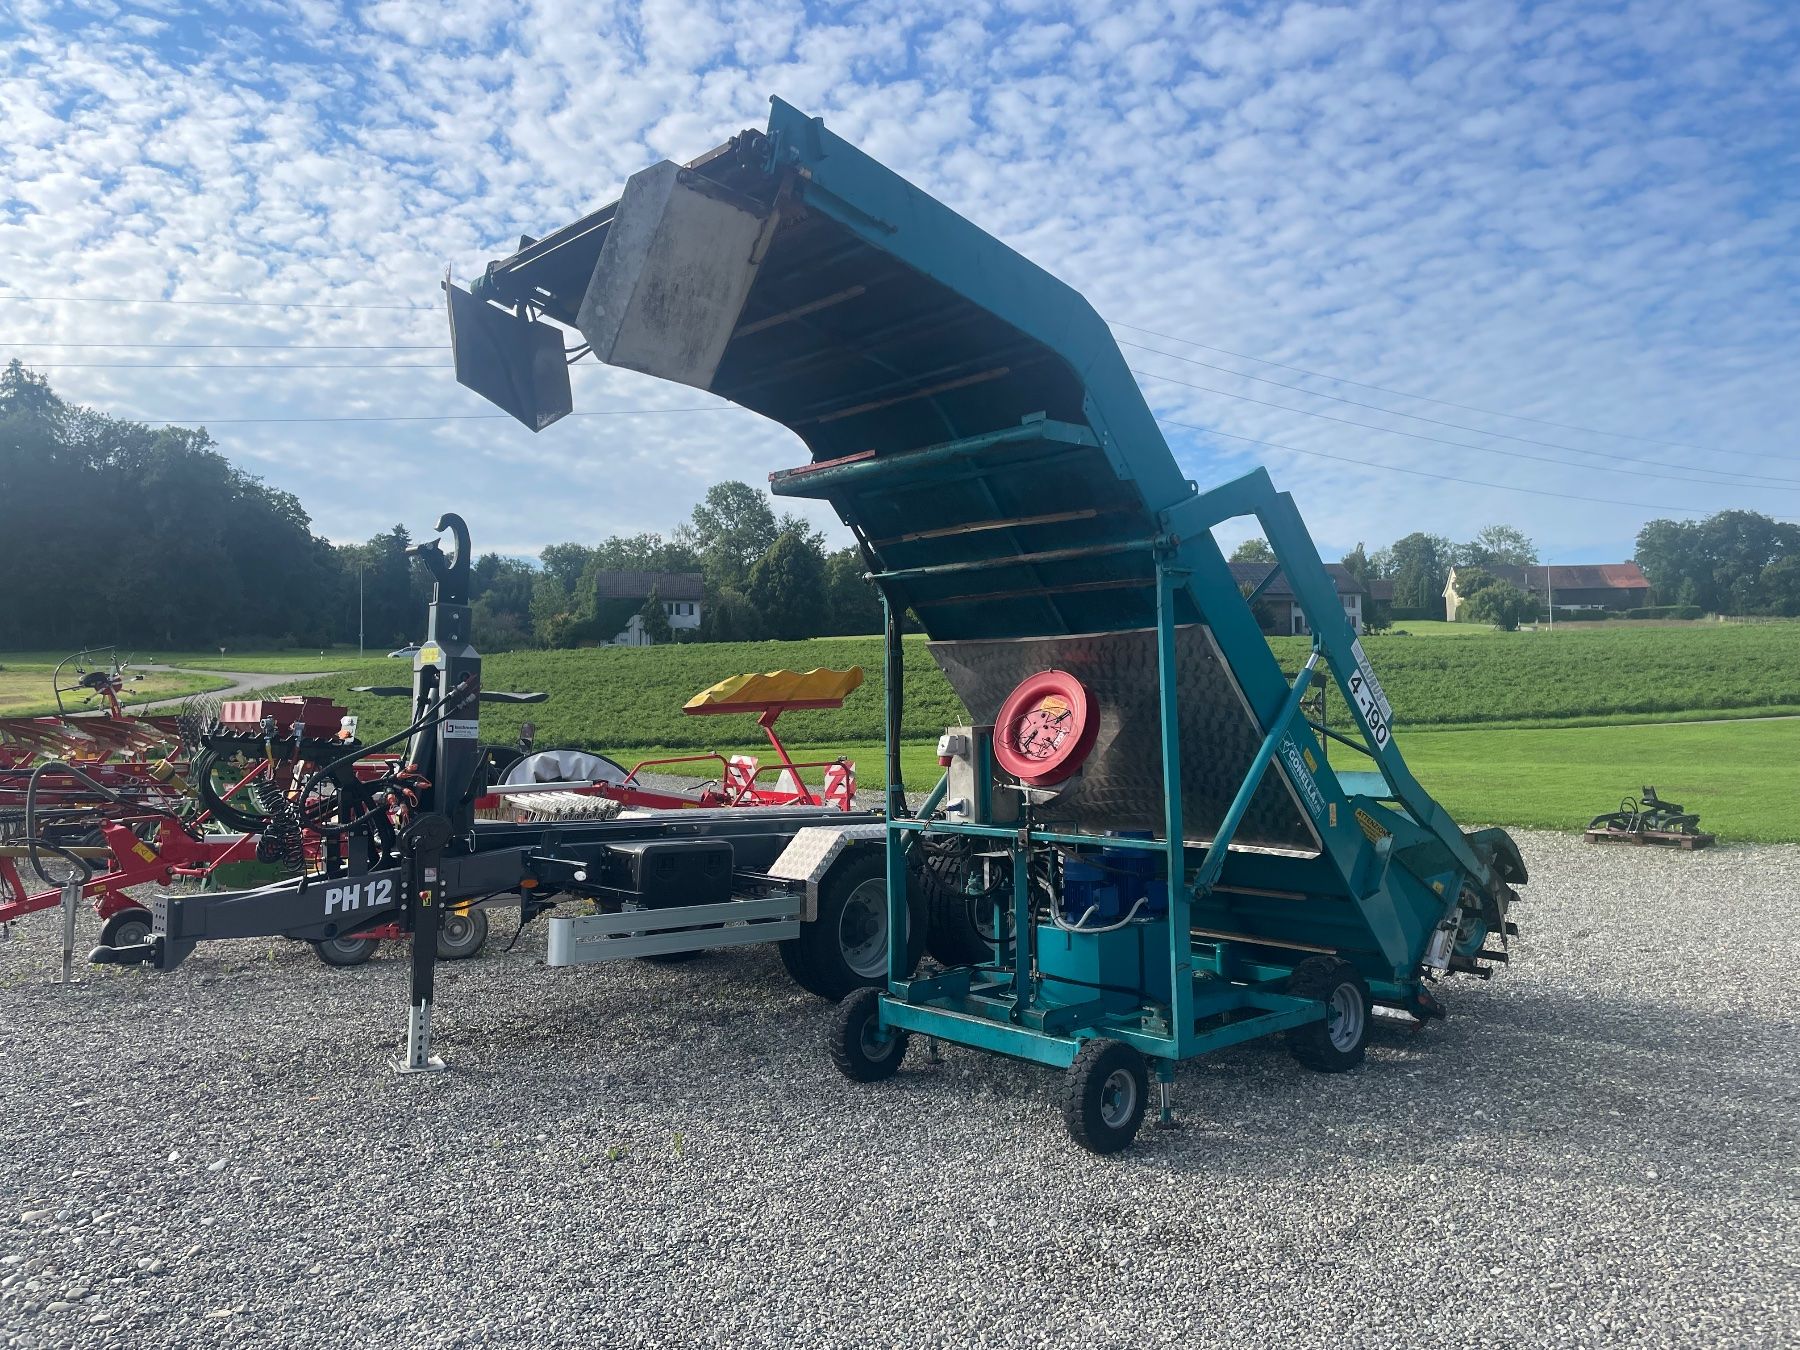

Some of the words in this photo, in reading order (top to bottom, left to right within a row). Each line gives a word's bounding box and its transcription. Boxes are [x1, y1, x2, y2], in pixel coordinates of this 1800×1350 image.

[1359, 655, 1385, 702] TAURUS
[1288, 749, 1317, 803] GONELLA
[324, 883, 361, 915] PH
[363, 878, 393, 907] 12
